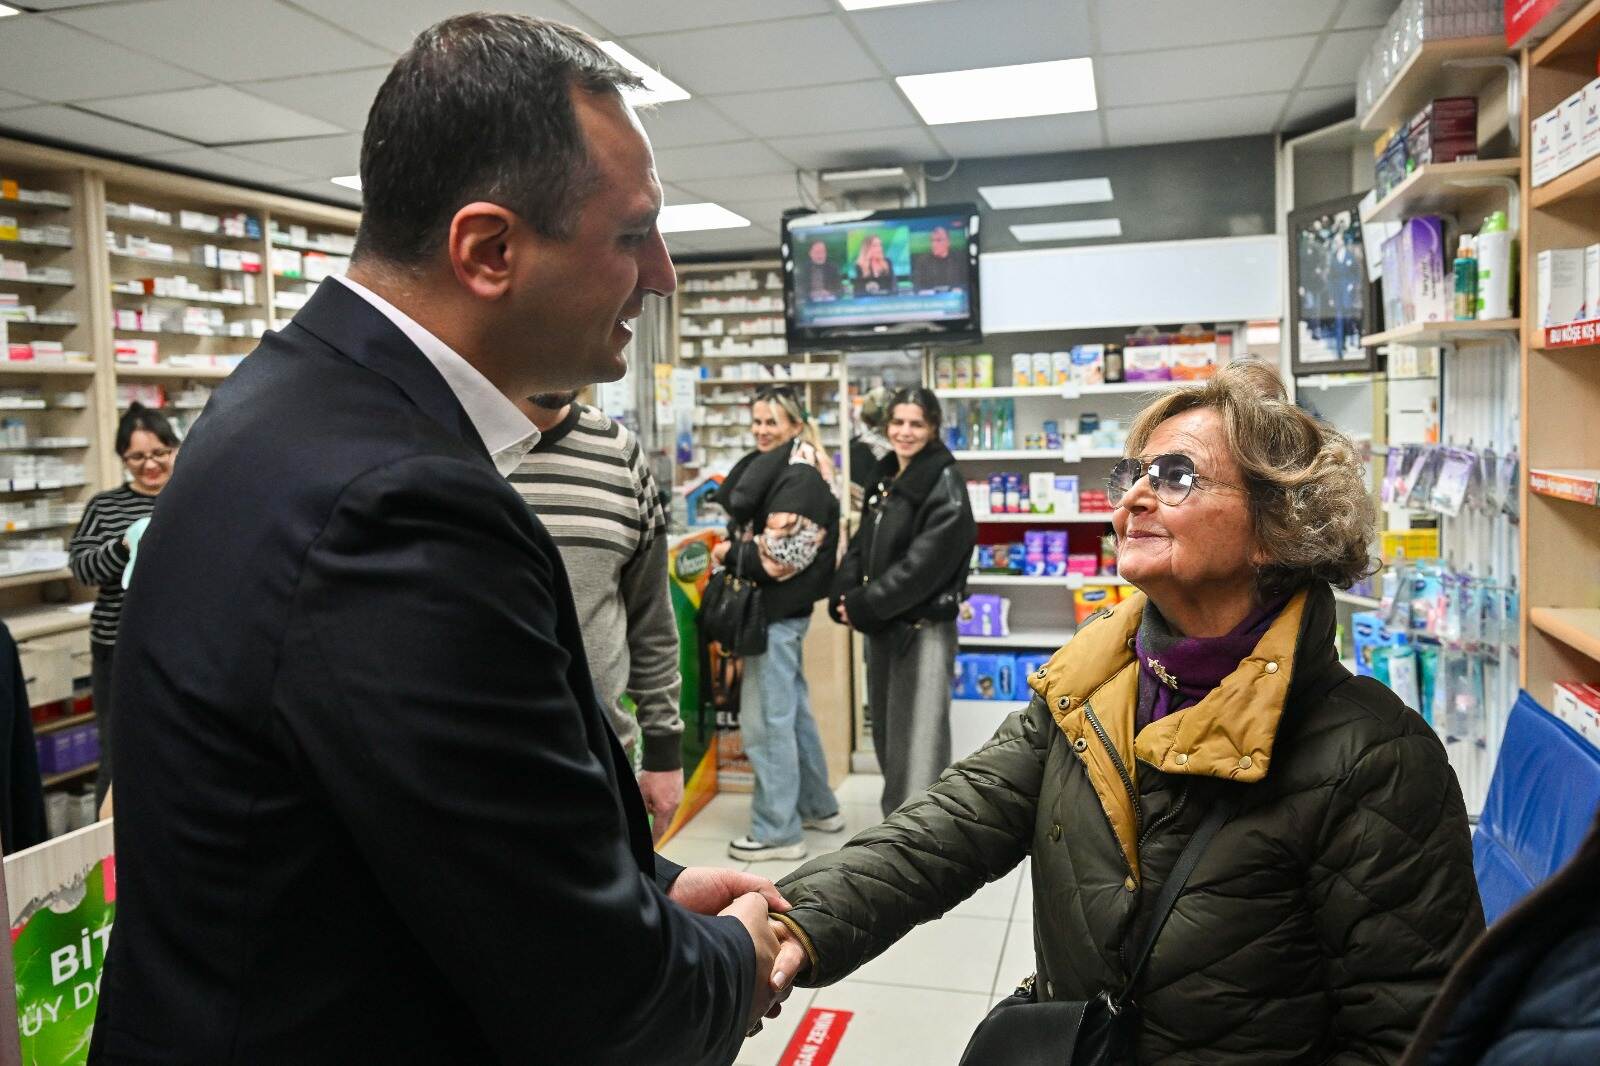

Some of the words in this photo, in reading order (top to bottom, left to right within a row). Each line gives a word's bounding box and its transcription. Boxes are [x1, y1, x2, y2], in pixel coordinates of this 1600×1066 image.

[50, 924, 114, 986] BİT
[18, 995, 63, 1037] ÜY
[793, 1043, 821, 1066] GAN
